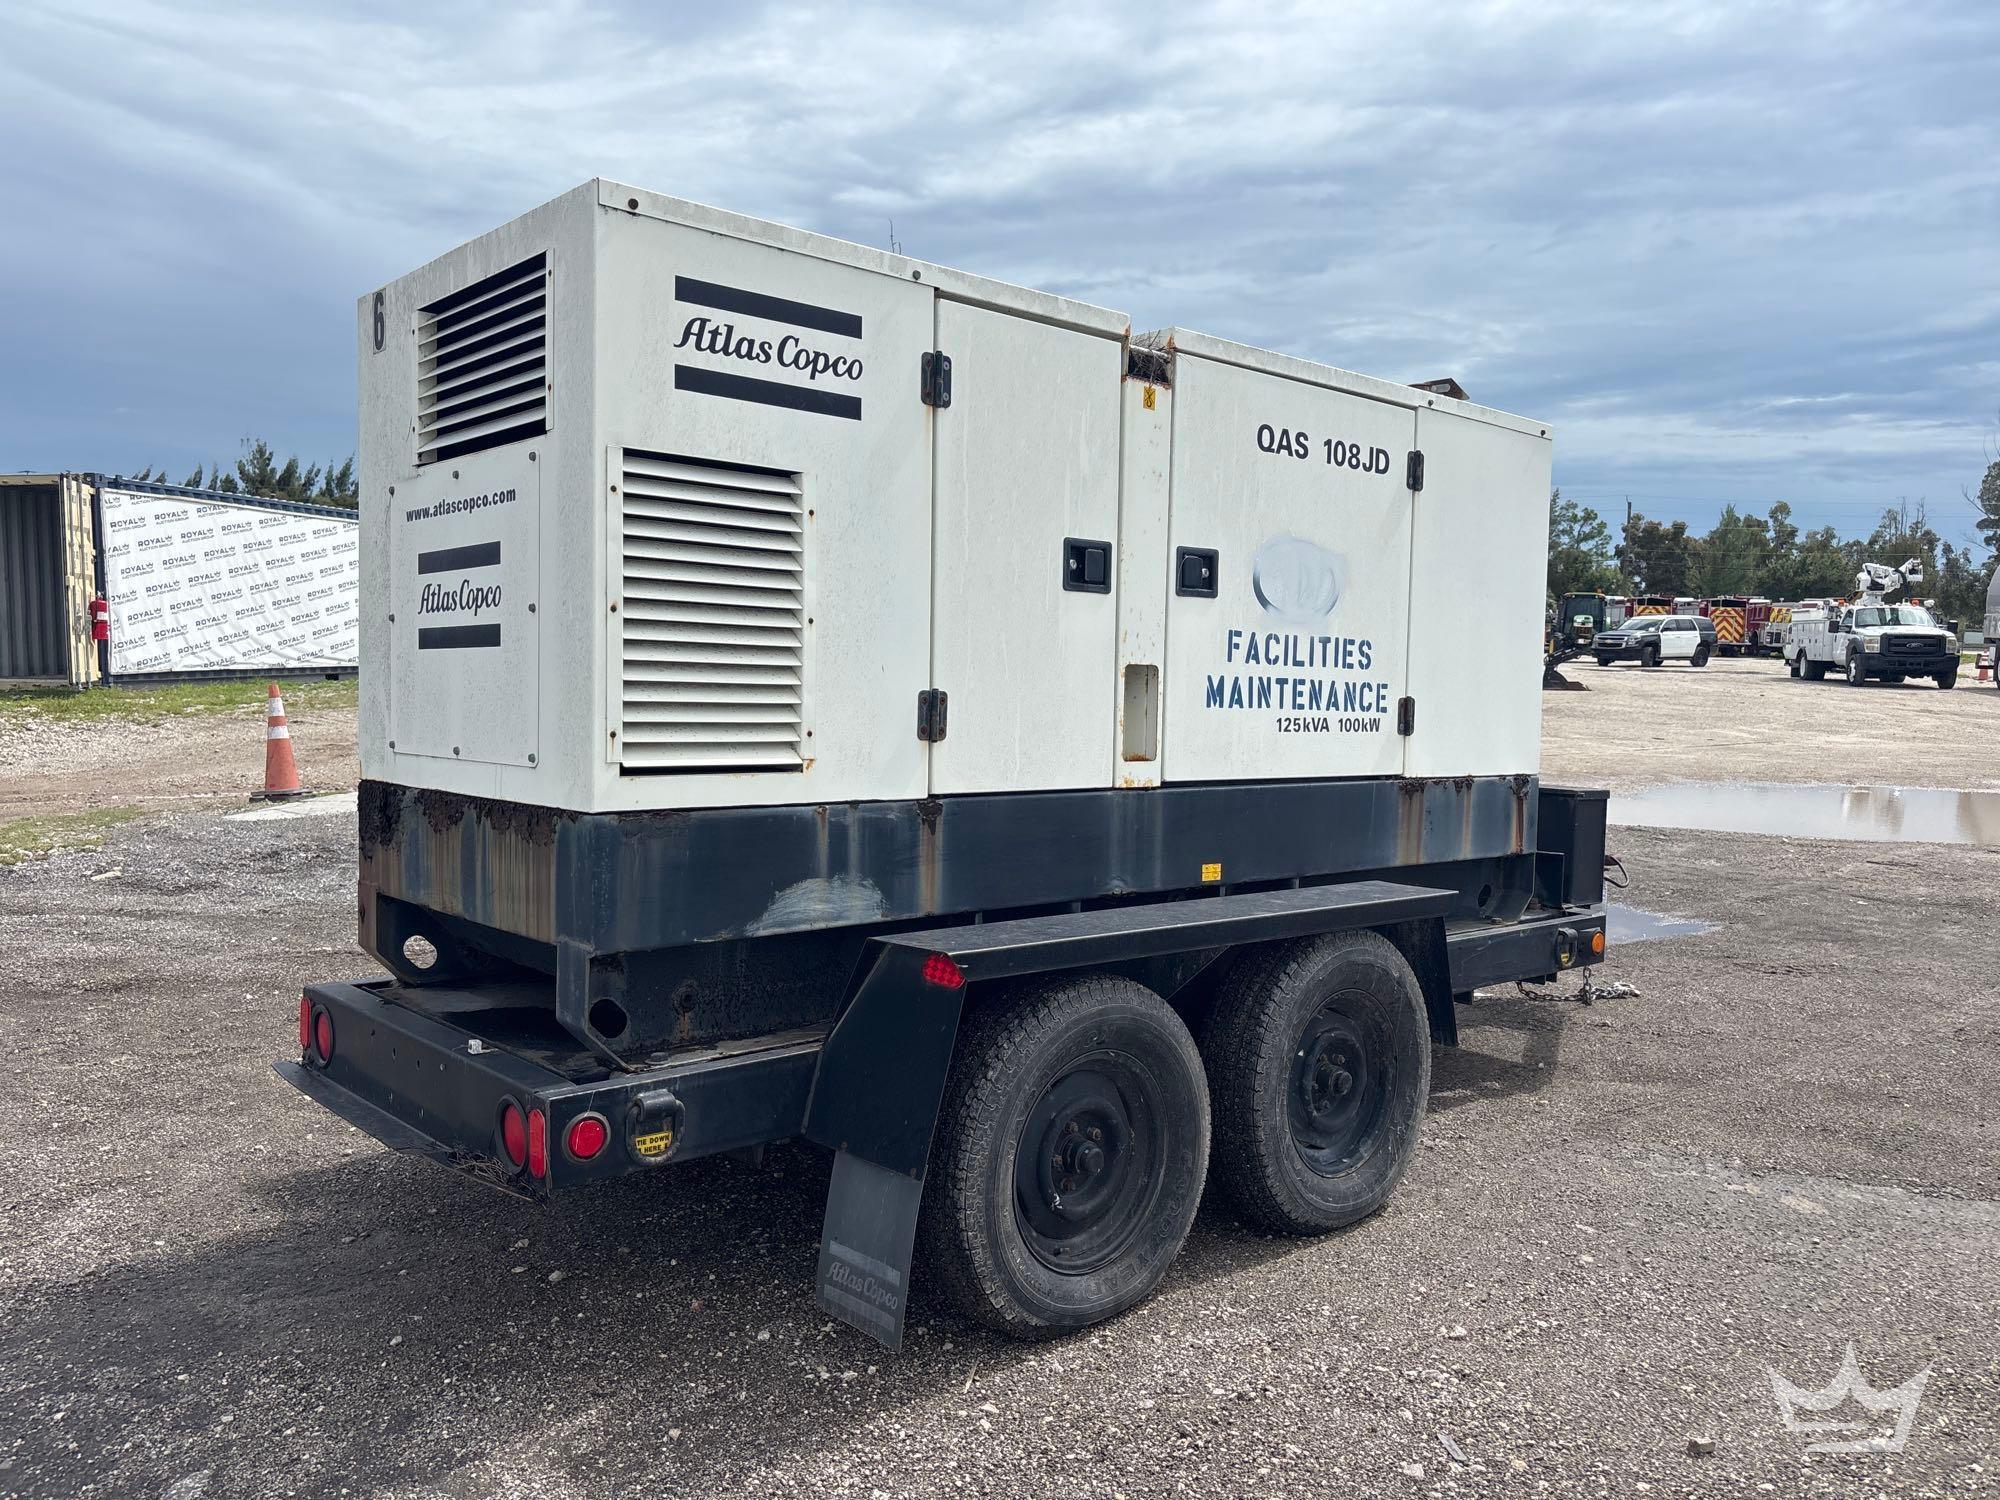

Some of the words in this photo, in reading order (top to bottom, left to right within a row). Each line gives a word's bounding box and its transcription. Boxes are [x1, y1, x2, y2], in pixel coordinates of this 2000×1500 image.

[374, 291, 384, 351] 6
[673, 317, 773, 364] Atlas
[777, 335, 864, 380] Copco
[1257, 423, 1309, 460] QAS
[1323, 438, 1390, 475] 108JD
[197, 504, 221, 513] ROYAL
[406, 488, 516, 522] www.atlascopco.com
[154, 511, 181, 520] ROYAL
[259, 516, 281, 525] ROYAL
[110, 518, 138, 528] ROYAL
[221, 523, 246, 532] ROYAL
[181, 530, 207, 539] ROYAL
[313, 527, 332, 535] ROYAL
[138, 538, 166, 547] ROYAL
[279, 533, 301, 542] ROYAL
[243, 541, 266, 549] ROYAL
[204, 547, 229, 557] ROYAL
[301, 550, 322, 558] ROYAL
[163, 556, 189, 565] ROYAL
[266, 557, 288, 566] ROYAL
[228, 565, 253, 574] ROYAL
[188, 573, 214, 583] ROYAL
[286, 574, 308, 582] ROYAL
[146, 582, 173, 593] ROYAL
[250, 581, 273, 591] ROYAL
[211, 590, 236, 600] ROYAL
[418, 583, 457, 615] Atlas
[460, 579, 501, 616] Copco
[170, 600, 196, 610] ROYAL
[272, 596, 294, 606] ROYAL
[127, 610, 154, 621] ROYAL
[235, 606, 259, 616] ROYAL
[196, 616, 221, 626] ROYAL
[291, 612, 313, 621] ROYAL
[256, 621, 279, 632] ROYAL
[154, 627, 181, 638] ROYAL
[218, 632, 243, 642] ROYAL
[178, 642, 204, 654] ROYAL
[242, 647, 265, 657] ROYAL
[1226, 629, 1372, 670] FACILITIES
[136, 655, 163, 667] ROYAL
[1206, 674, 1389, 714] MAINTENANCE
[1276, 717, 1330, 733] 125kVA
[1338, 717, 1381, 733] 100kW
[650, 1134, 670, 1144] DOWN
[644, 1145, 661, 1153] HERE
[825, 1261, 864, 1292] Atlas
[863, 1277, 898, 1310] Copco
